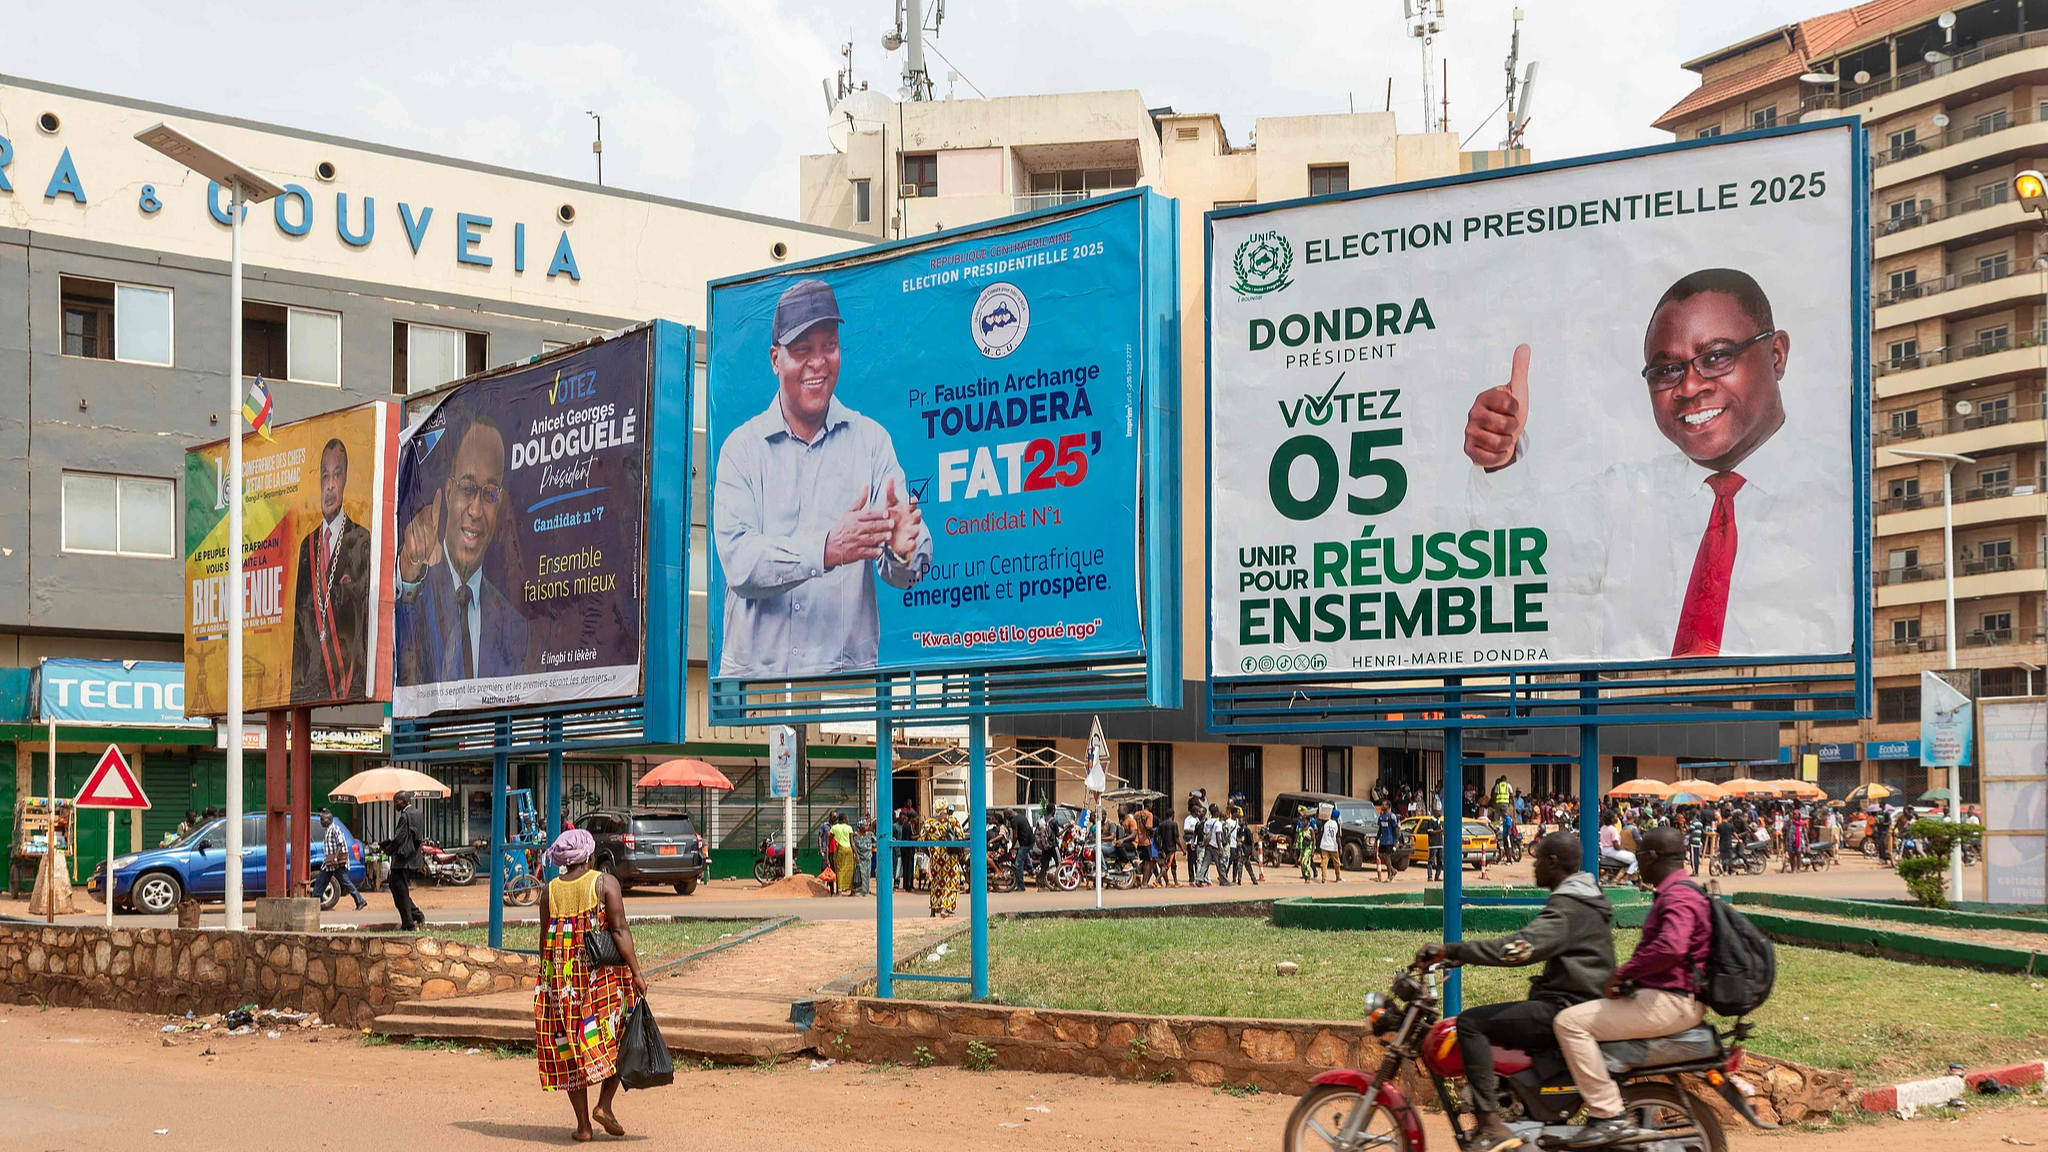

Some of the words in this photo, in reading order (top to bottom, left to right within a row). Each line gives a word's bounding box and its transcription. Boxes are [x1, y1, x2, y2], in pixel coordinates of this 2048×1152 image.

[138, 184, 163, 213] &
[207, 179, 582, 280] GOUVEIA
[1305, 219, 1452, 265] ELECTION
[1463, 182, 1739, 244] PRESIDENTIELLE
[1749, 170, 1828, 207] 2025
[929, 248, 987, 270] REPUBLIQUE
[989, 231, 1072, 258] CENTRAFRICAINE
[1249, 230, 1277, 243] UNIR
[902, 269, 959, 293] ELECTION
[963, 248, 1068, 279] PRESIDENTIELLE
[1073, 241, 1104, 259] 2025
[1249, 297, 1436, 352] DONDRA
[1285, 343, 1397, 369] PRÉSIDENT
[909, 388, 929, 409] Pr.
[935, 377, 1000, 404] Faustin
[1003, 364, 1100, 393] Archange
[921, 387, 1093, 439] TOUADERA
[1278, 378, 1402, 428] VOTEZ
[530, 412, 564, 436] Anicet
[566, 403, 615, 426] Georges
[511, 408, 637, 470] DOLOGUÉLÉ
[242, 454, 275, 477] CONFÉRENCE
[276, 451, 287, 469] DES
[287, 447, 306, 467] CHEFS
[539, 455, 598, 495] Président
[1268, 427, 1408, 521] 05
[263, 488, 286, 500] Septembre
[286, 484, 299, 494] 2025
[265, 472, 274, 489] DE
[274, 471, 281, 487] LA
[281, 467, 301, 486] CEMAC
[533, 512, 581, 533] Candidat
[945, 509, 1026, 536] Candidat
[194, 551, 202, 562] LE
[203, 547, 226, 561] PEUPLE
[206, 563, 220, 574] VOUS
[258, 556, 267, 566] LA
[538, 545, 602, 576] Ensemble
[964, 560, 985, 577] un
[990, 546, 1104, 576] Centrafrique
[1239, 545, 1297, 568] UNIR
[1239, 569, 1309, 592] POUR
[1313, 524, 1548, 588] RÉUSSIR
[193, 566, 283, 626] BIENENUE
[524, 579, 570, 603] faisons
[573, 572, 616, 595] mieux
[902, 580, 990, 608] émergent
[995, 579, 1014, 600] et
[1020, 570, 1111, 602] prospère.
[250, 618, 260, 627] SUR
[260, 618, 267, 626] SA
[267, 615, 282, 624] TERRE
[1239, 582, 1549, 646] ENSEMBLE
[193, 627, 199, 635] ET
[199, 626, 207, 634] UN
[953, 634, 961, 643] a
[999, 628, 1009, 641] ti
[1011, 626, 1025, 640] lo
[1027, 622, 1065, 644] goué
[567, 650, 574, 663] ti
[1352, 651, 1465, 669] HENRI-MARIE
[1473, 647, 1549, 663] DONDRA
[49, 679, 184, 710] TECNO
[445, 686, 466, 696] seront
[467, 684, 476, 693] les
[505, 682, 513, 691] et
[513, 680, 522, 690] les
[522, 678, 548, 691] premiers
[549, 677, 569, 689] seront
[569, 675, 579, 685] les
[481, 695, 506, 705] Matthieu
[1819, 744, 1841, 756] obank
[1879, 742, 1909, 754] Ecobank
